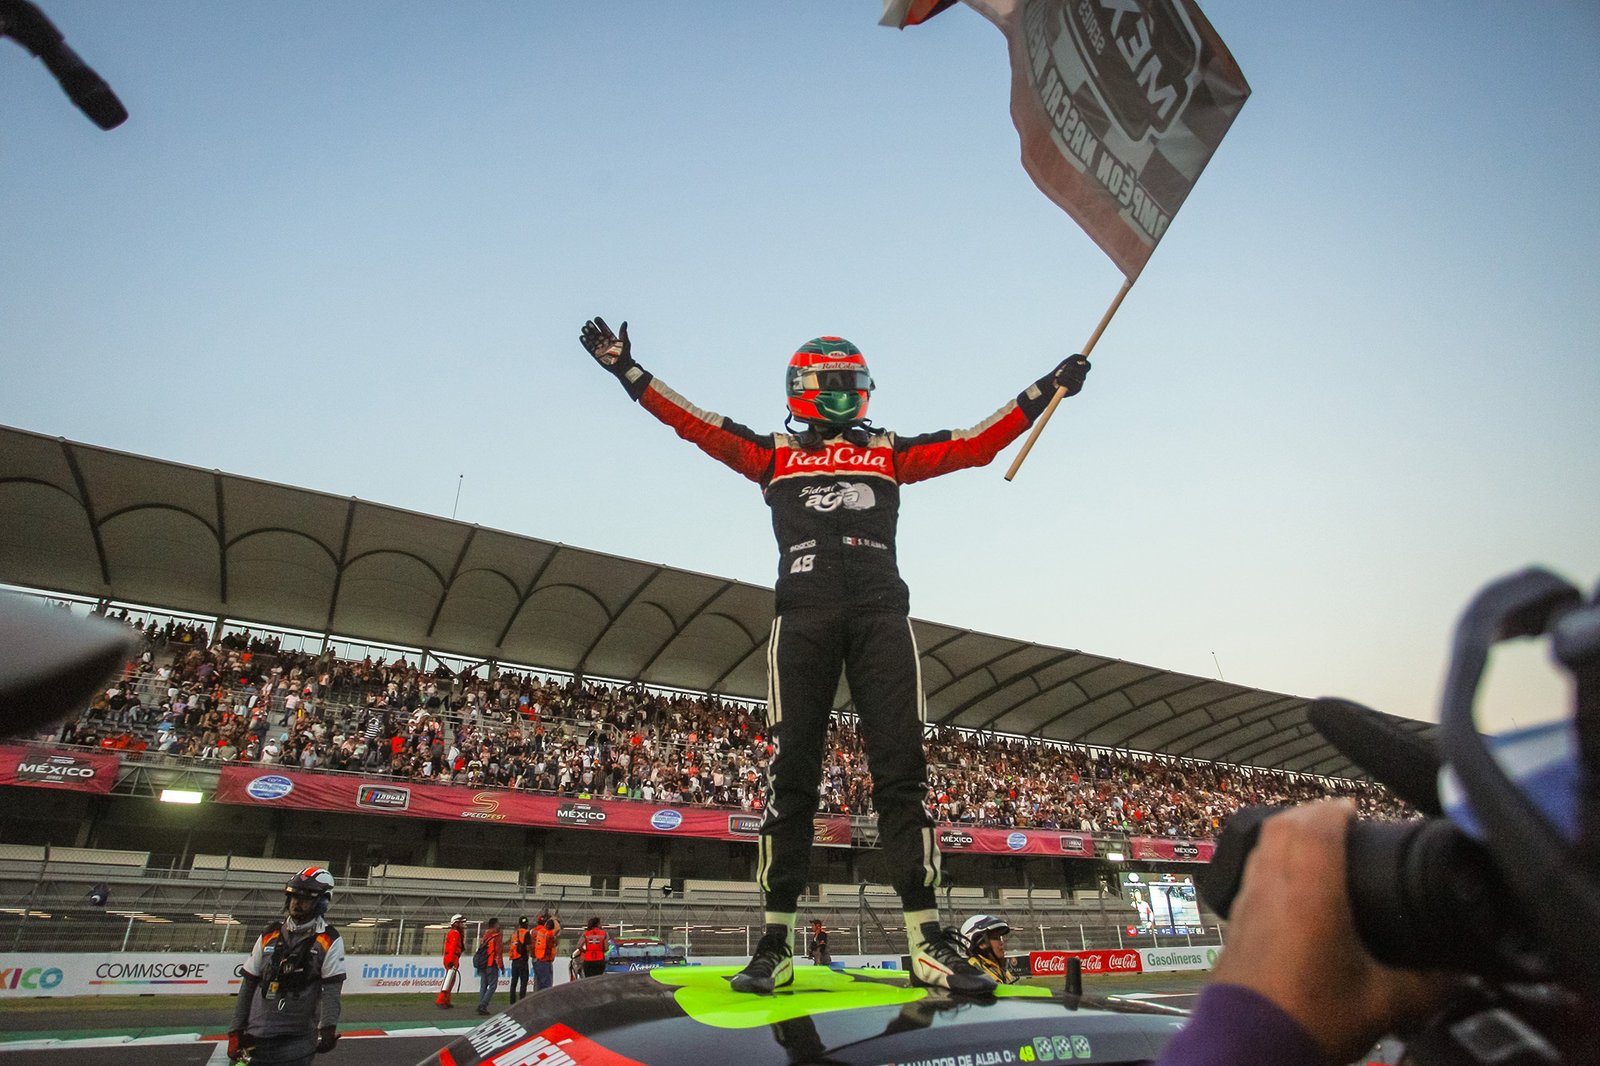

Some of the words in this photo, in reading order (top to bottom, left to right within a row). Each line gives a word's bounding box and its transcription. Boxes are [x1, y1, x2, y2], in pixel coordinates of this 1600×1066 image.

[789, 554, 817, 574] 48
[18, 763, 95, 778] MÉXICO
[461, 811, 507, 820] SPEEDFEST
[557, 809, 606, 820] MÉXICO
[1147, 953, 1202, 967] Gasolineras
[362, 964, 446, 978] infinitum
[957, 1055, 973, 1066] DE
[975, 1051, 1002, 1065] ALBA
[1019, 1045, 1035, 1063] 48
